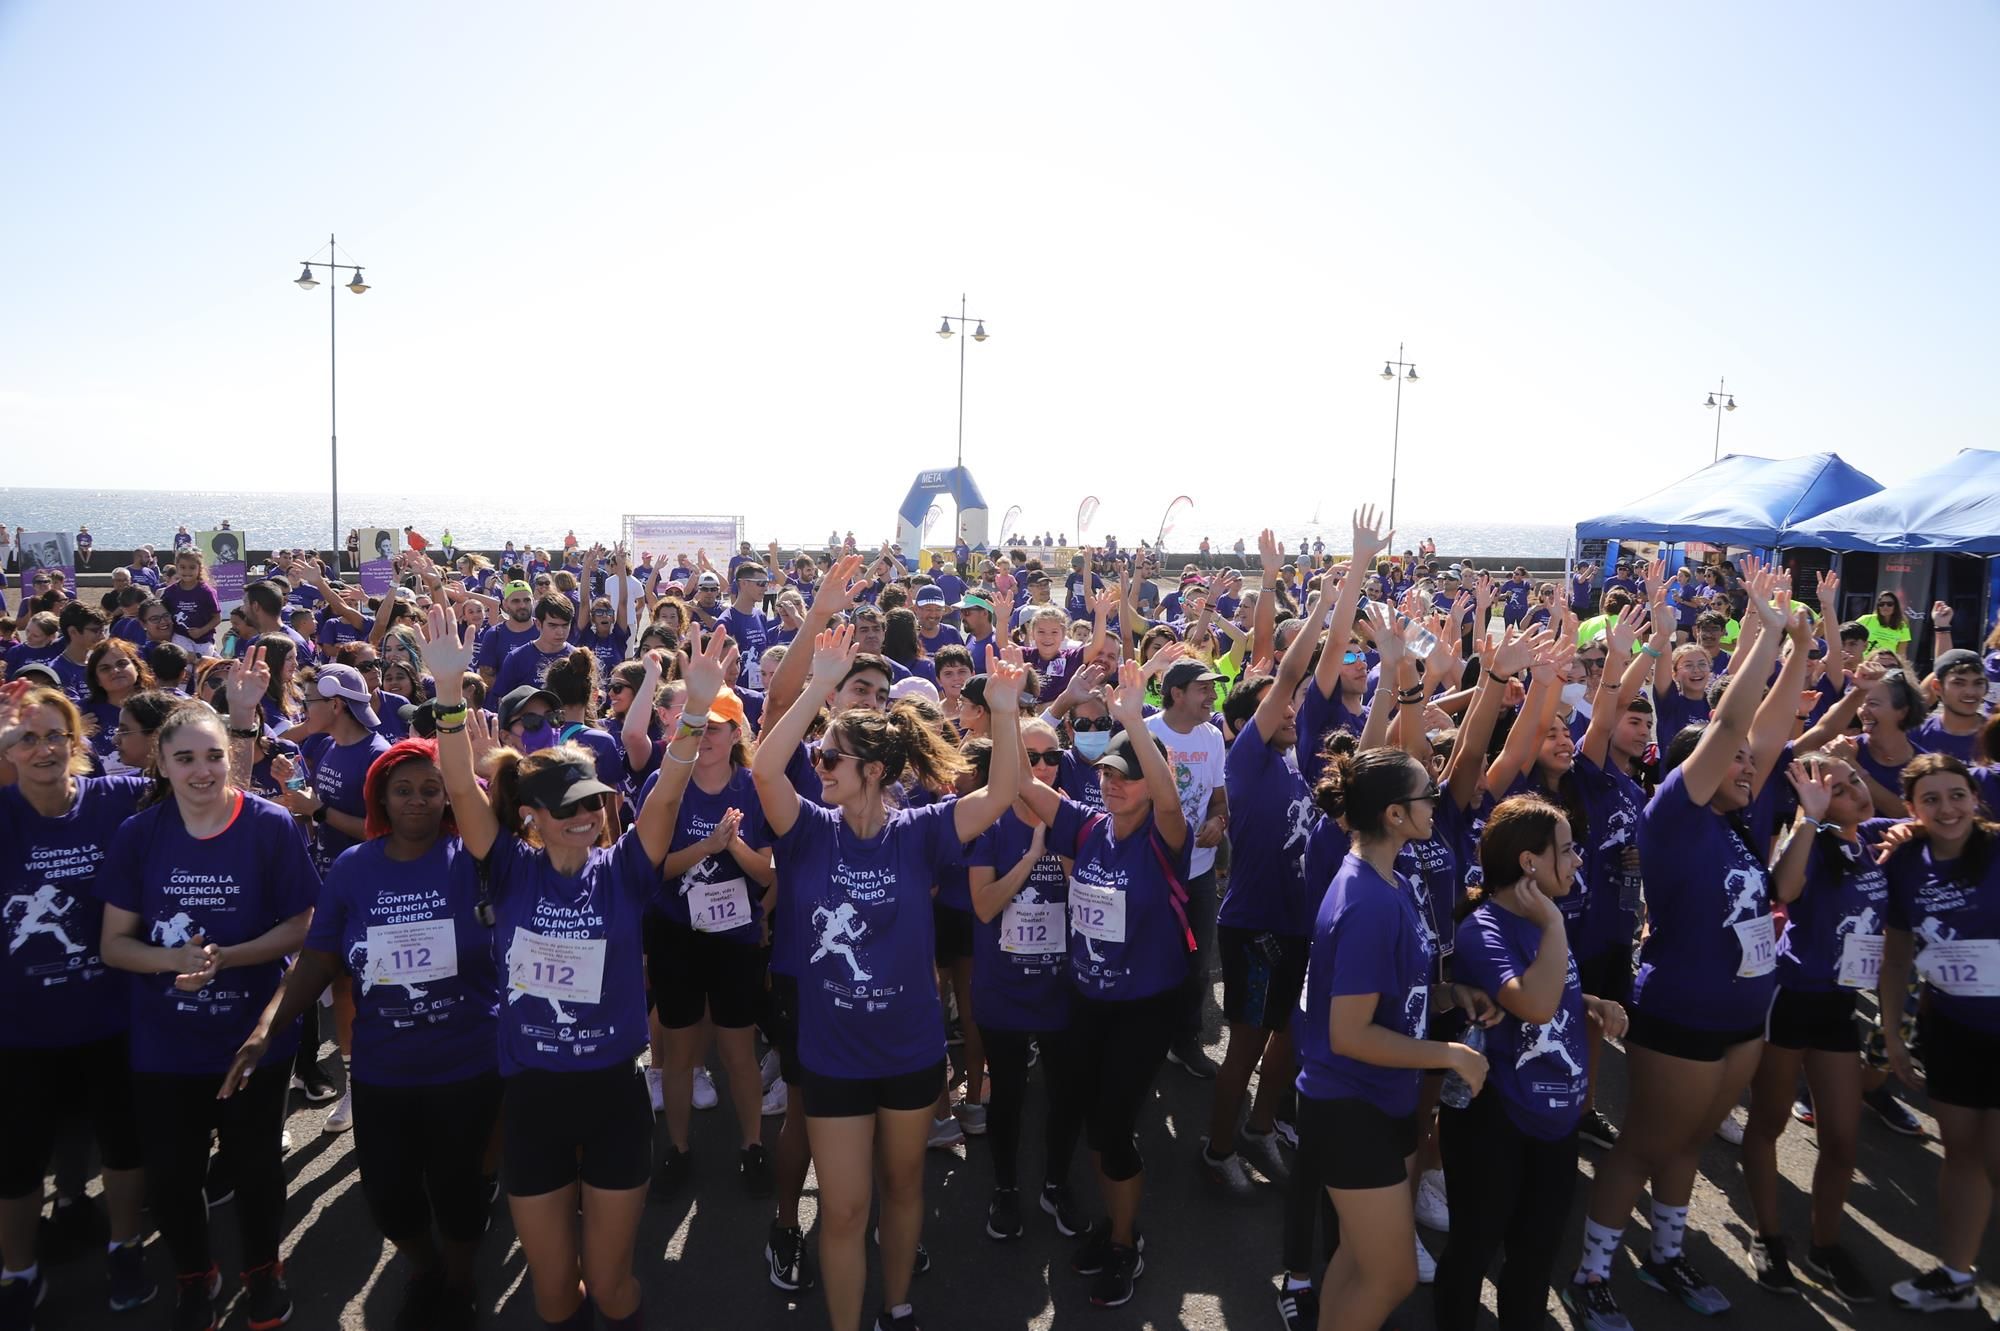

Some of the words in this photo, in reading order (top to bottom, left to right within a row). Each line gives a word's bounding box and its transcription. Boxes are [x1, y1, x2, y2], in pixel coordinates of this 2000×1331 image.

[921, 472, 942, 483] META
[31, 847, 81, 860] CONTRA
[82, 844, 98, 853] LA
[25, 855, 90, 871] VIOLENCIA
[91, 851, 105, 861] DE
[44, 864, 95, 879] GÉNERO
[1115, 870, 1126, 878] LA
[170, 875, 216, 884] CONTRA
[219, 875, 233, 883] LA
[883, 875, 896, 884] DE
[163, 886, 222, 895] VIOLENCIA
[225, 886, 240, 894] DE
[180, 896, 226, 906] GÉNERO
[377, 893, 422, 905] CONTRA
[425, 890, 439, 899] LA
[370, 902, 429, 915] VIOLENCIA
[432, 898, 446, 908] DE
[536, 905, 580, 918] CONTRA
[581, 904, 594, 915] LA
[708, 902, 736, 920] 112
[387, 911, 433, 924] GÉNERO
[1078, 905, 1104, 926] 112
[532, 916, 586, 929] IOLENCIA
[588, 916, 603, 926] DE
[542, 930, 590, 939] GÉNERO
[1017, 926, 1047, 942] 112
[1755, 941, 1772, 962] 112
[392, 948, 432, 969] 112
[533, 961, 575, 986] 112
[1938, 964, 1978, 982] 112
[216, 991, 227, 999] ICI
[873, 989, 883, 997] ICI
[432, 1000, 443, 1010] ICI
[578, 1030, 590, 1039] ICI
